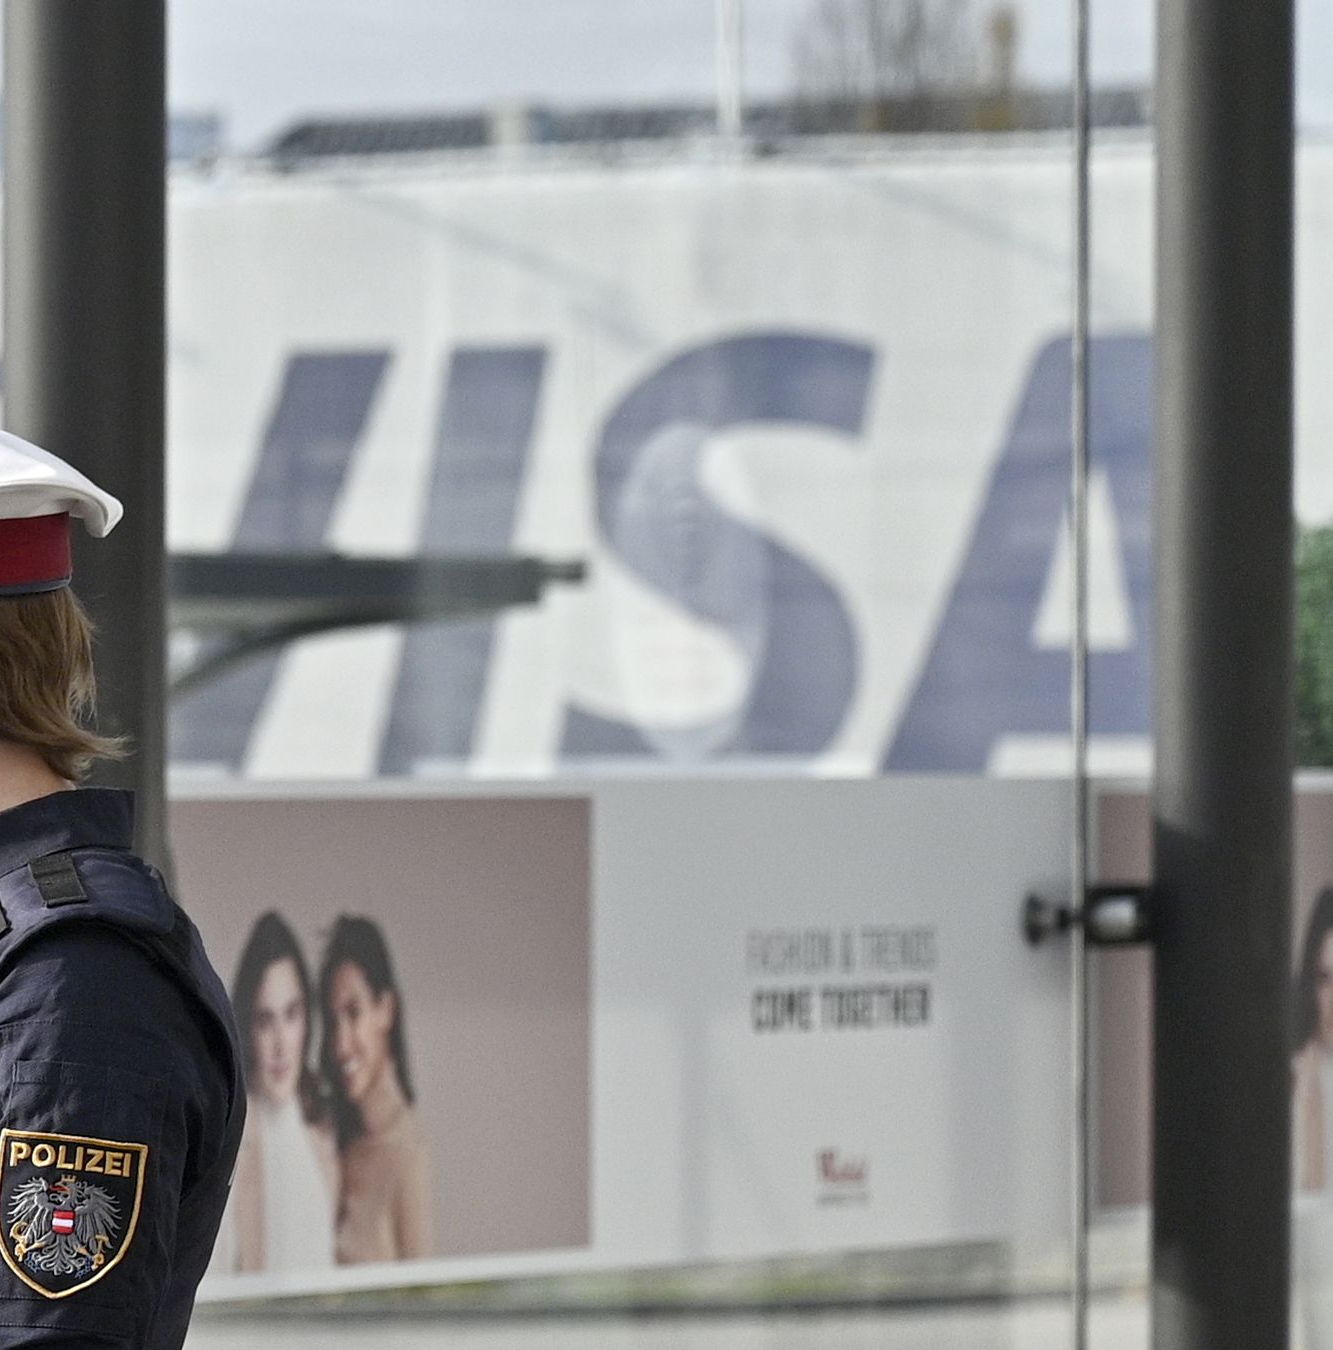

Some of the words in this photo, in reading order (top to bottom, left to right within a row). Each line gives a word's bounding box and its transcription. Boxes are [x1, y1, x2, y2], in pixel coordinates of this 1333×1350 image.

[750, 986, 813, 1033] COME
[819, 982, 931, 1029] TOGETHER
[9, 1141, 132, 1178] POLIZEI
